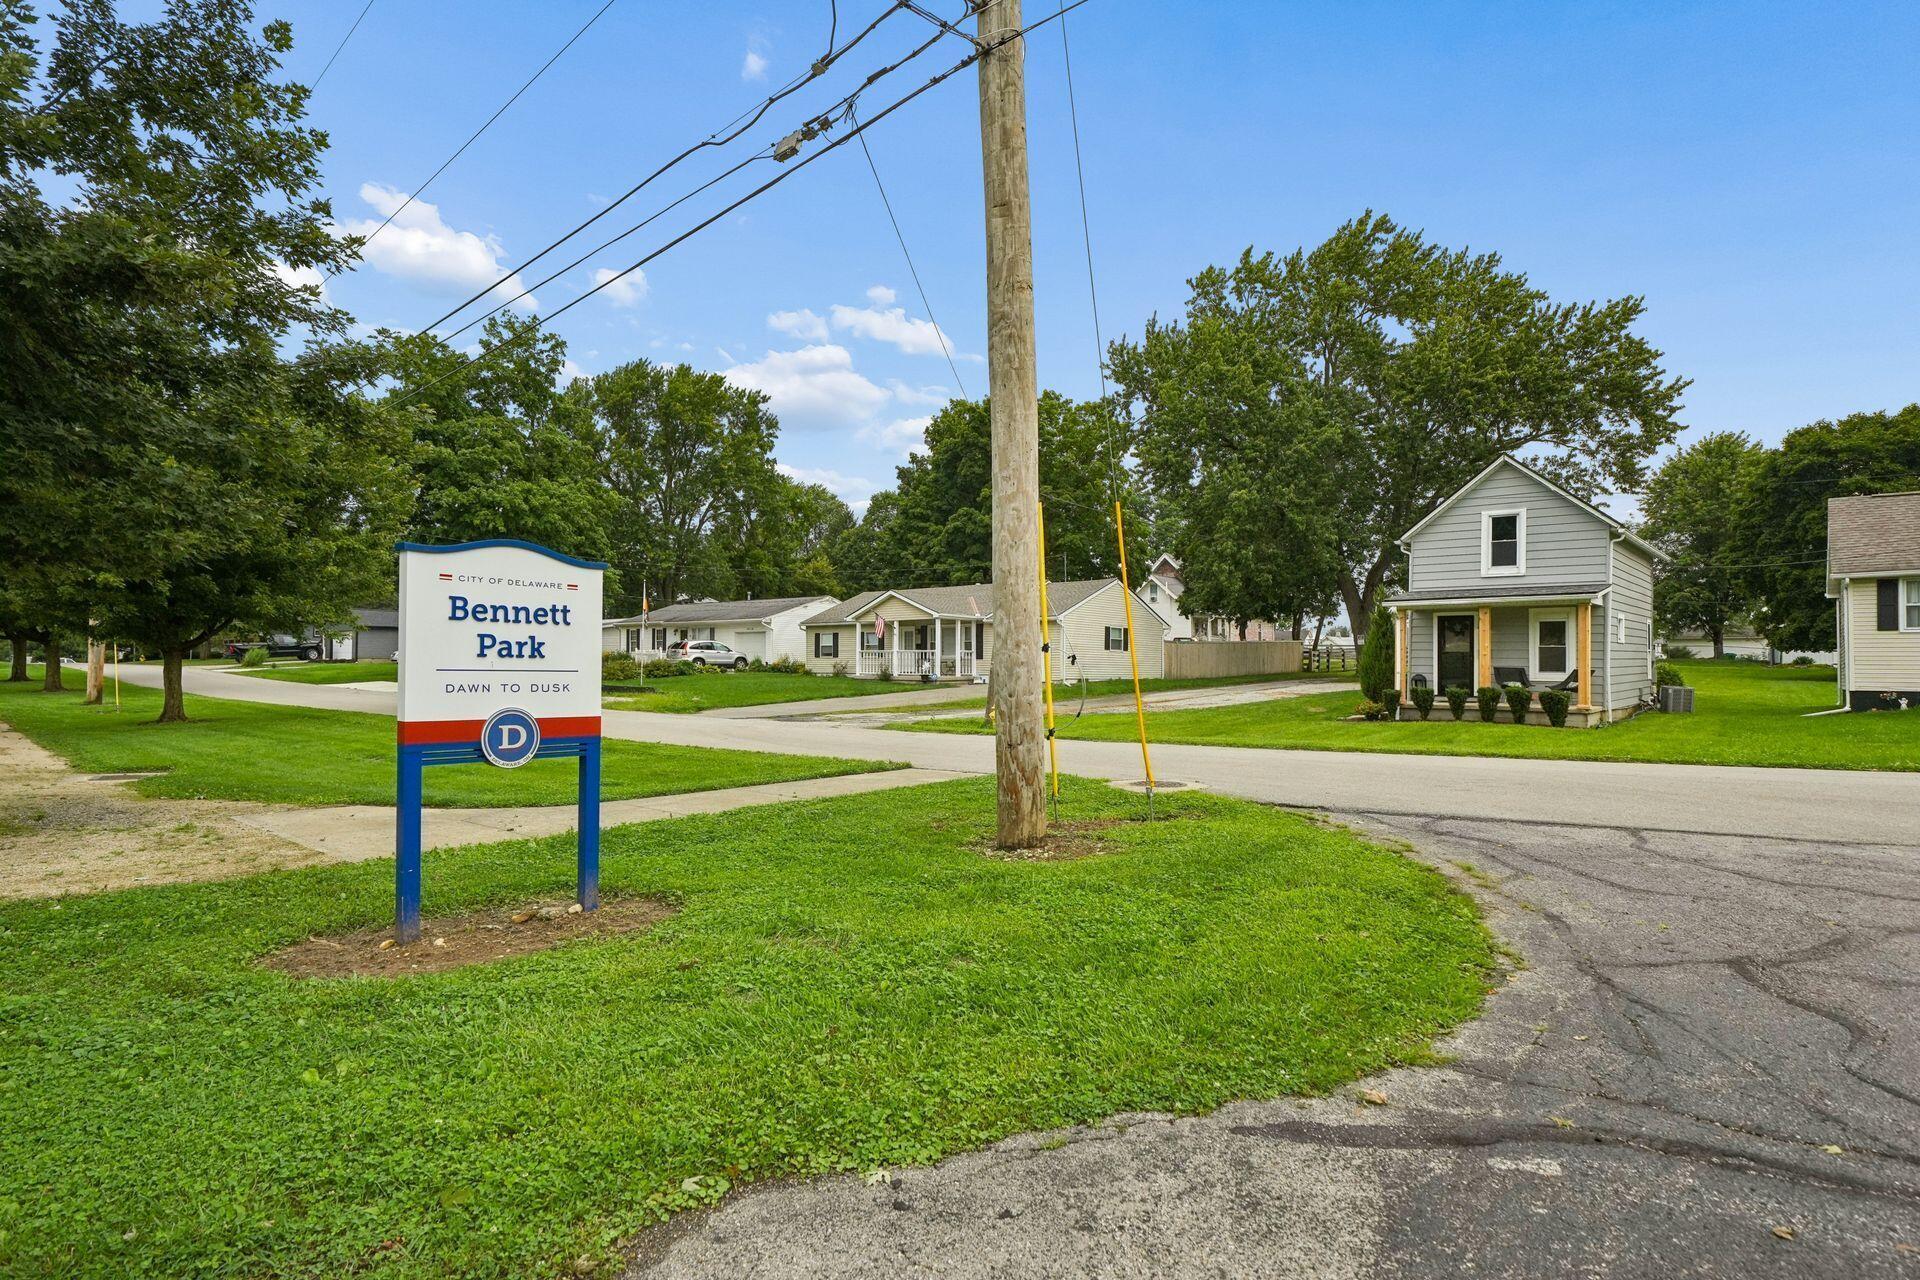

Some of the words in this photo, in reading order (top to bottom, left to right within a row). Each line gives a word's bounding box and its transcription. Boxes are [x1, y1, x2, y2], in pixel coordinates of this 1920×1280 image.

[458, 575, 484, 583] CITY
[507, 579, 563, 589] DELAWARE
[448, 595, 571, 626] Bennett
[477, 633, 546, 659] Park
[445, 683, 491, 693] DAWN
[500, 683, 521, 693] TO
[530, 683, 571, 693] DUSK
[498, 724, 527, 749] D
